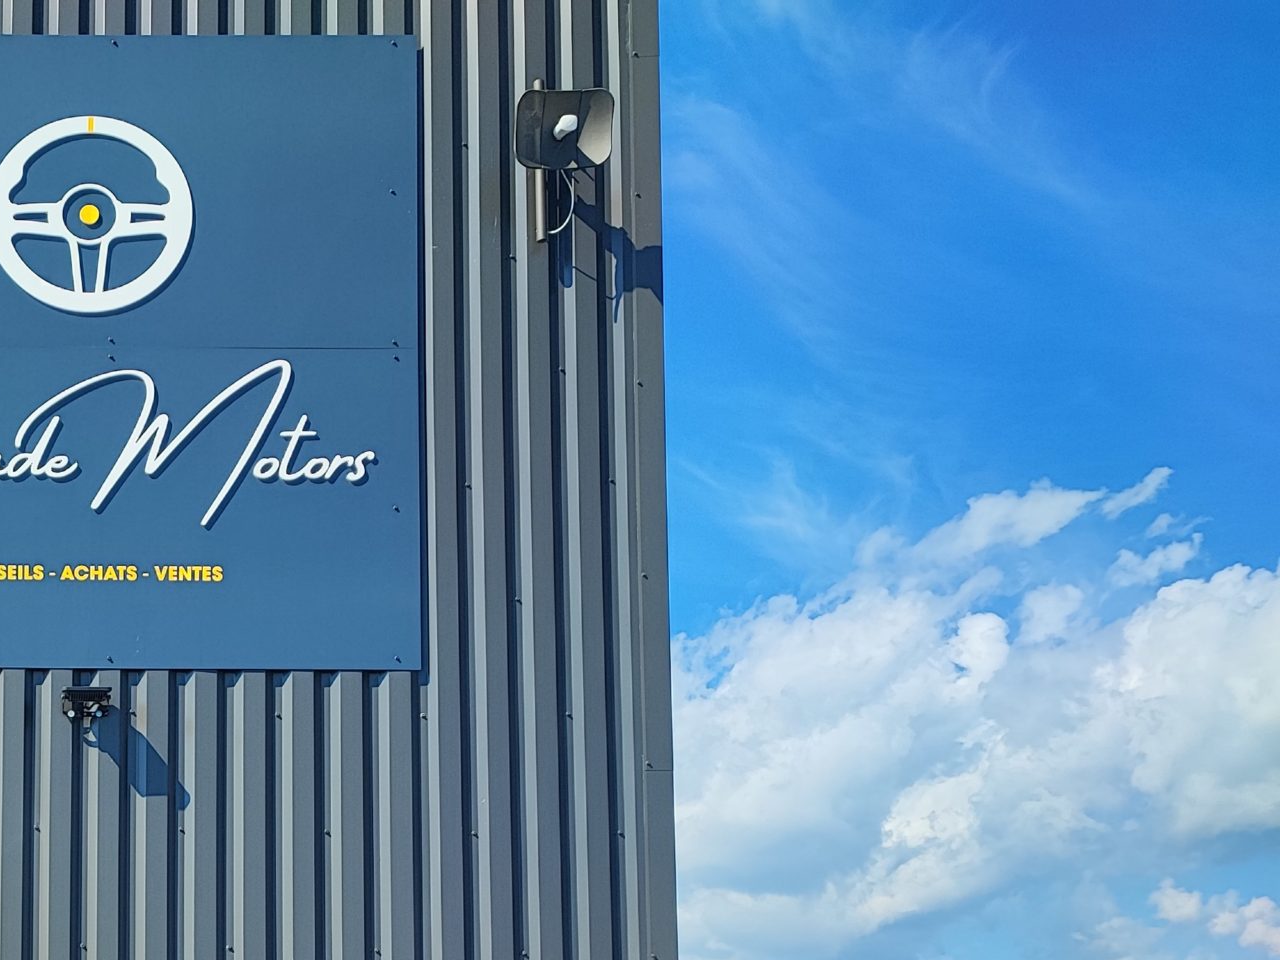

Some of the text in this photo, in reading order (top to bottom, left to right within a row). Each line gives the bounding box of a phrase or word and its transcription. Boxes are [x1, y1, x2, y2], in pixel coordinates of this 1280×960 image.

[15, 359, 377, 529] Motors
[60, 565, 138, 581] ACHATS
[154, 565, 224, 582] VENTES
